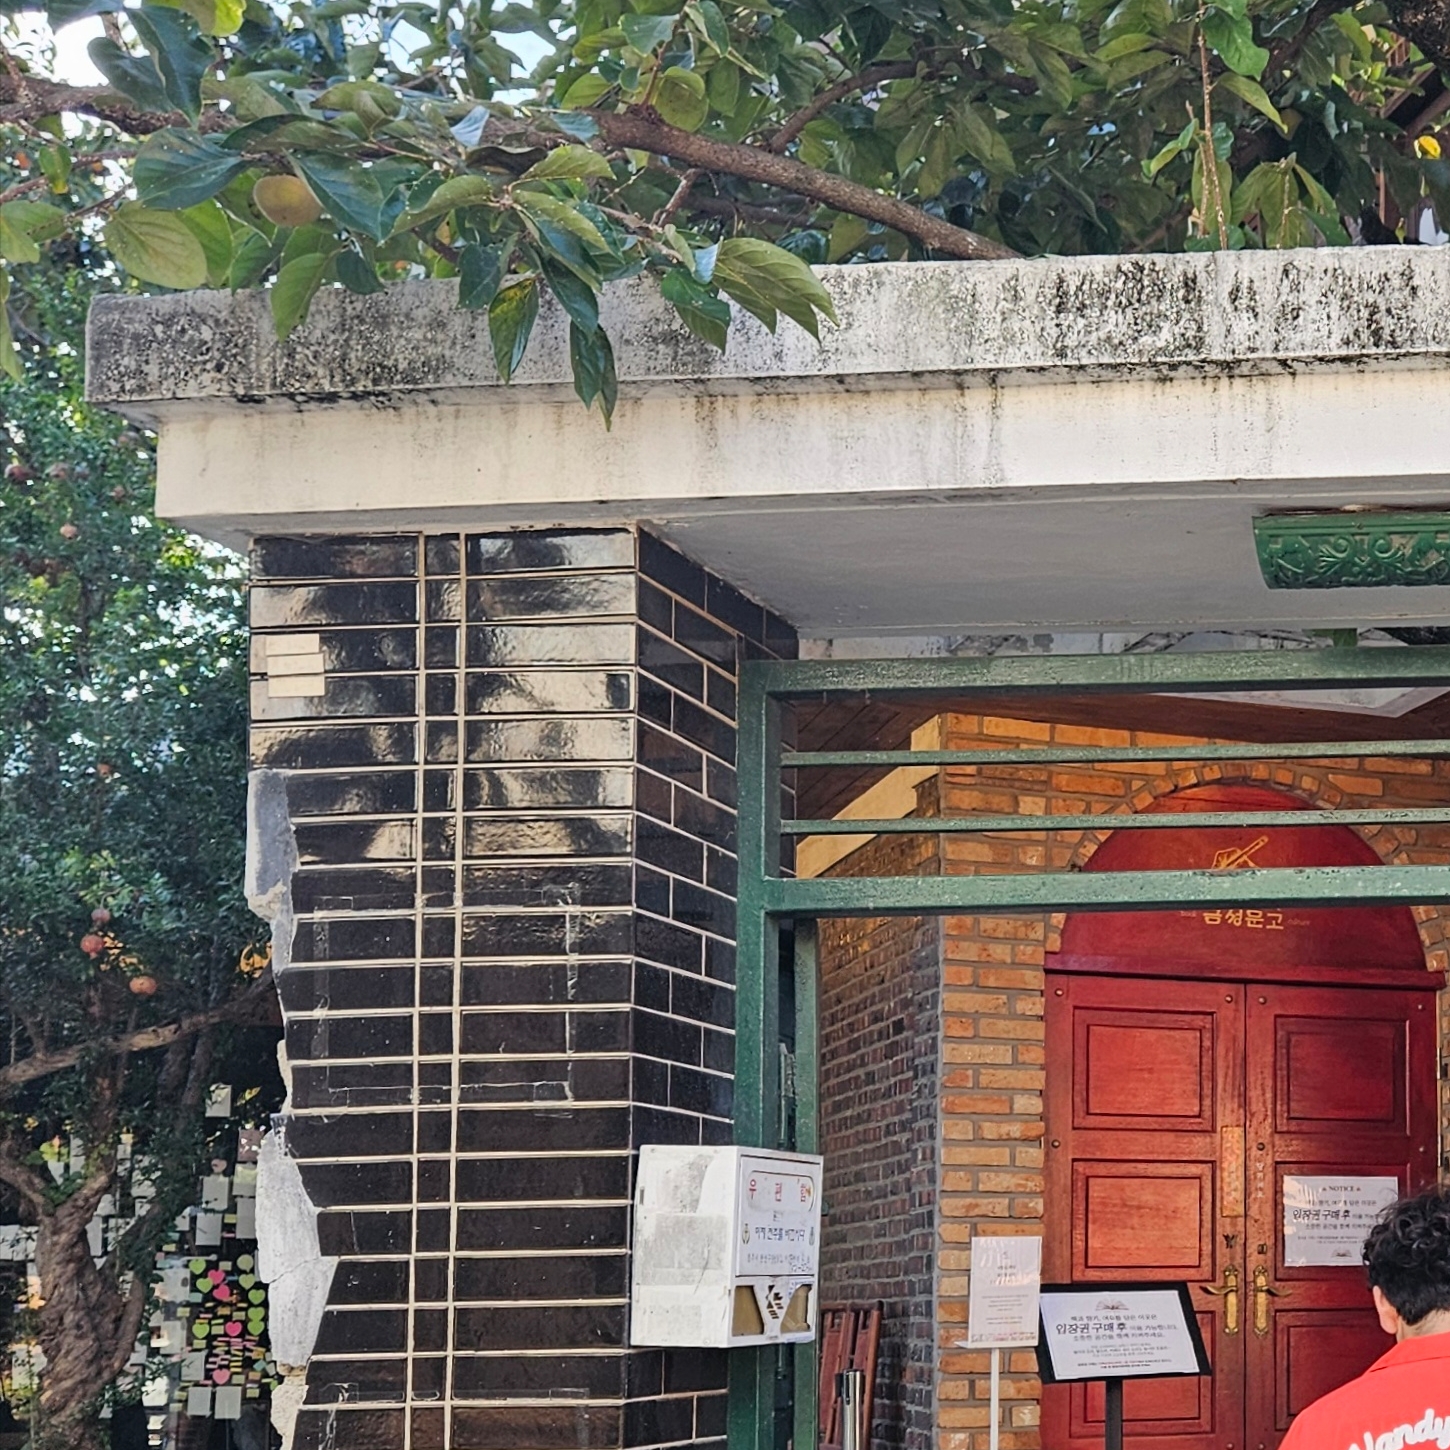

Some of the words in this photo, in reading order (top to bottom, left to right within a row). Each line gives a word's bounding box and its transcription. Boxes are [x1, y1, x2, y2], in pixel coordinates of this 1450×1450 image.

[1322, 1209, 1340, 1220] 구매
[1056, 1323, 1090, 1335] 입장권
[1092, 1323, 1114, 1334] 구매
[1116, 1322, 1127, 1332] 후
